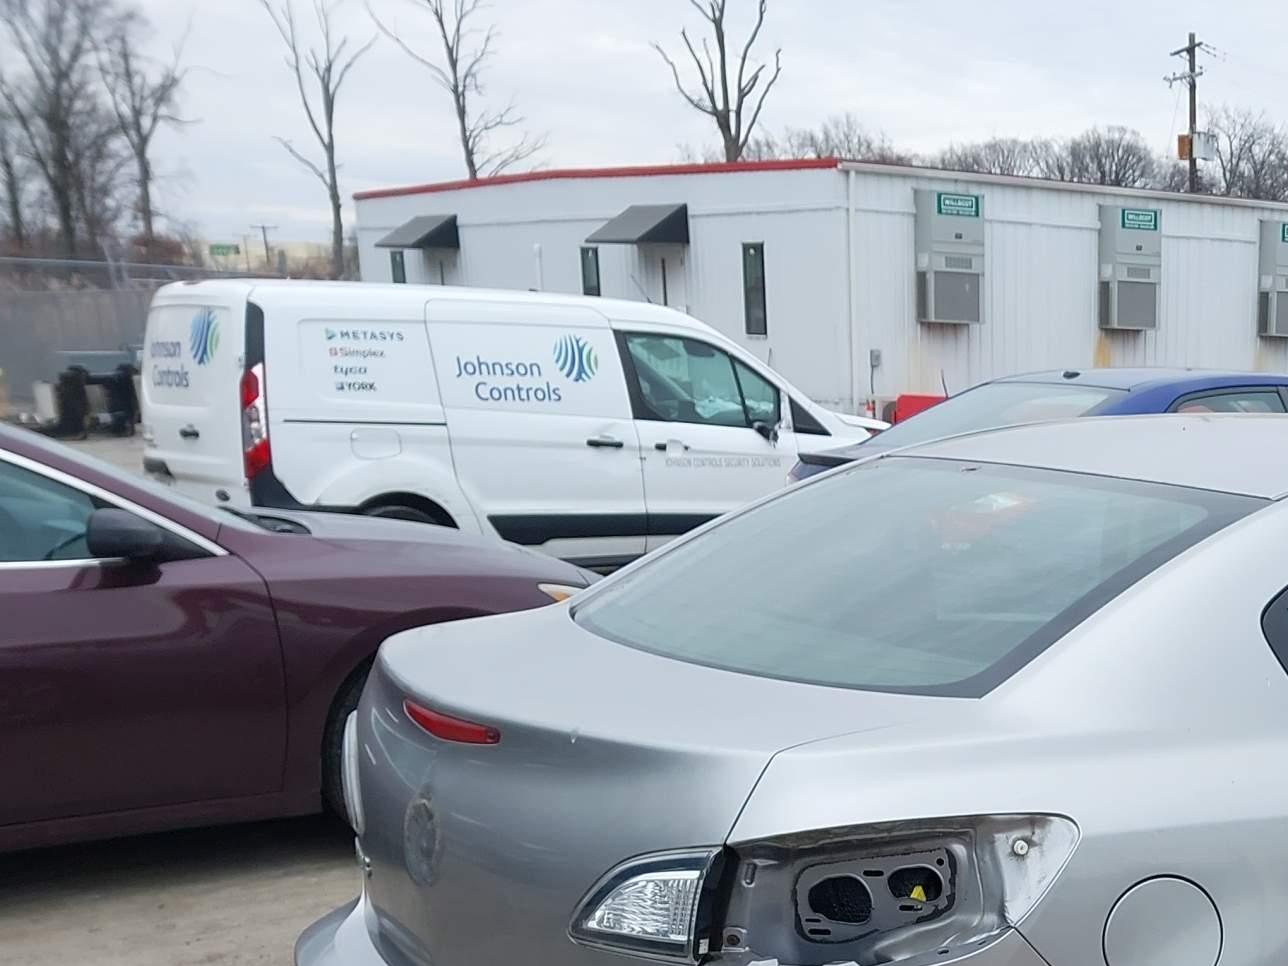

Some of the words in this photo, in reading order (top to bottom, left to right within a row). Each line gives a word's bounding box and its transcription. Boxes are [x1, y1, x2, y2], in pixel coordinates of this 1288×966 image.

[340, 330, 404, 341] METASYS
[456, 355, 542, 378] Johnson
[346, 381, 377, 391] YORK
[475, 381, 562, 402] Controls
